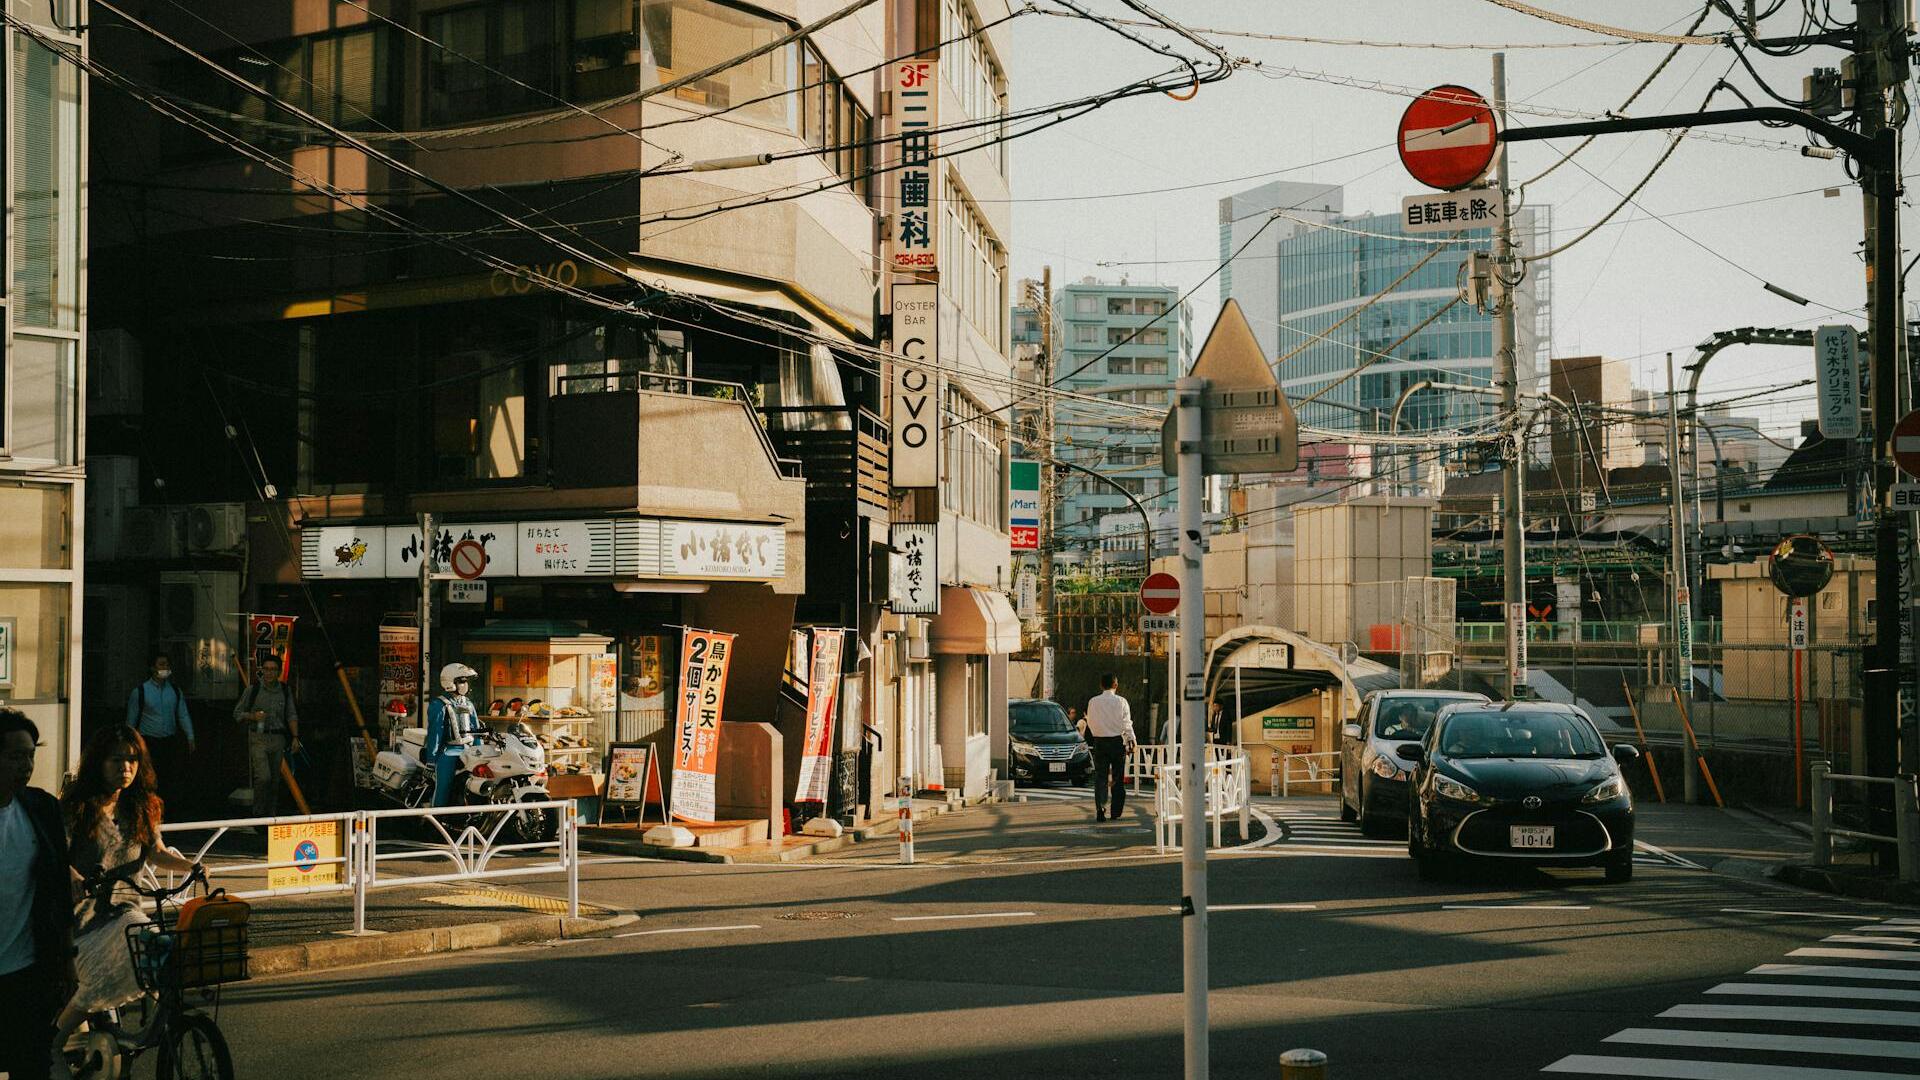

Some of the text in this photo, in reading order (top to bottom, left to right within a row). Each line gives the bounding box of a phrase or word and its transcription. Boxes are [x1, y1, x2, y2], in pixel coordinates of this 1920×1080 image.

[900, 64, 930, 88] 3F
[900, 91, 930, 249] 三田歯科
[1408, 198, 1498, 225] 自転車を除く
[902, 337, 928, 448] COVO
[1825, 336, 1843, 415] 代々木クリニック
[527, 527, 561, 539] 打ちたて
[544, 557, 578, 570] 揚げたて
[1793, 620, 1805, 645] 注意
[681, 637, 708, 766] 2個サービス!
[699, 641, 726, 728] 鳥から天
